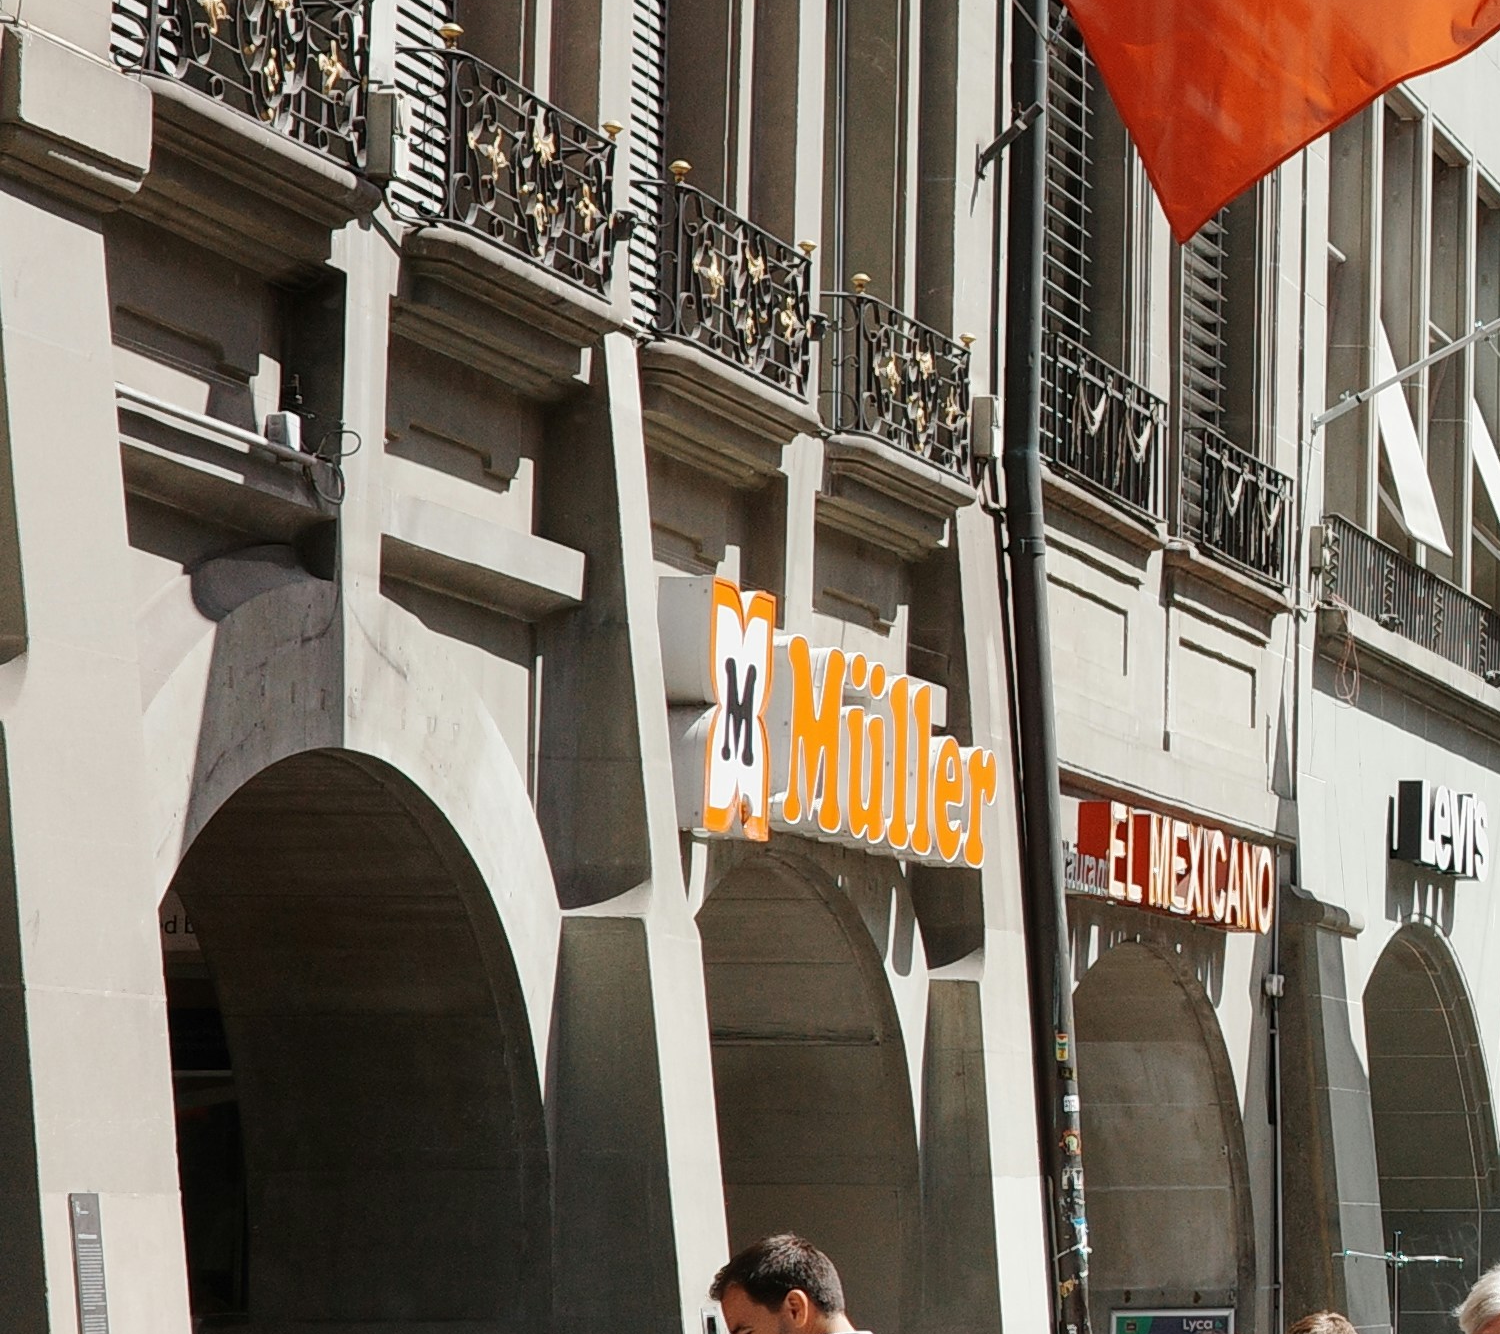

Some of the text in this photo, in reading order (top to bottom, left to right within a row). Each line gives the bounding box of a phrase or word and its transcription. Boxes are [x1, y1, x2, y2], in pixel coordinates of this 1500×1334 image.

[782, 634, 997, 869] Müller
[1108, 800, 1143, 903] EL
[1148, 813, 1275, 935] MEXICANO
[1182, 1318, 1213, 1332] Lyca
